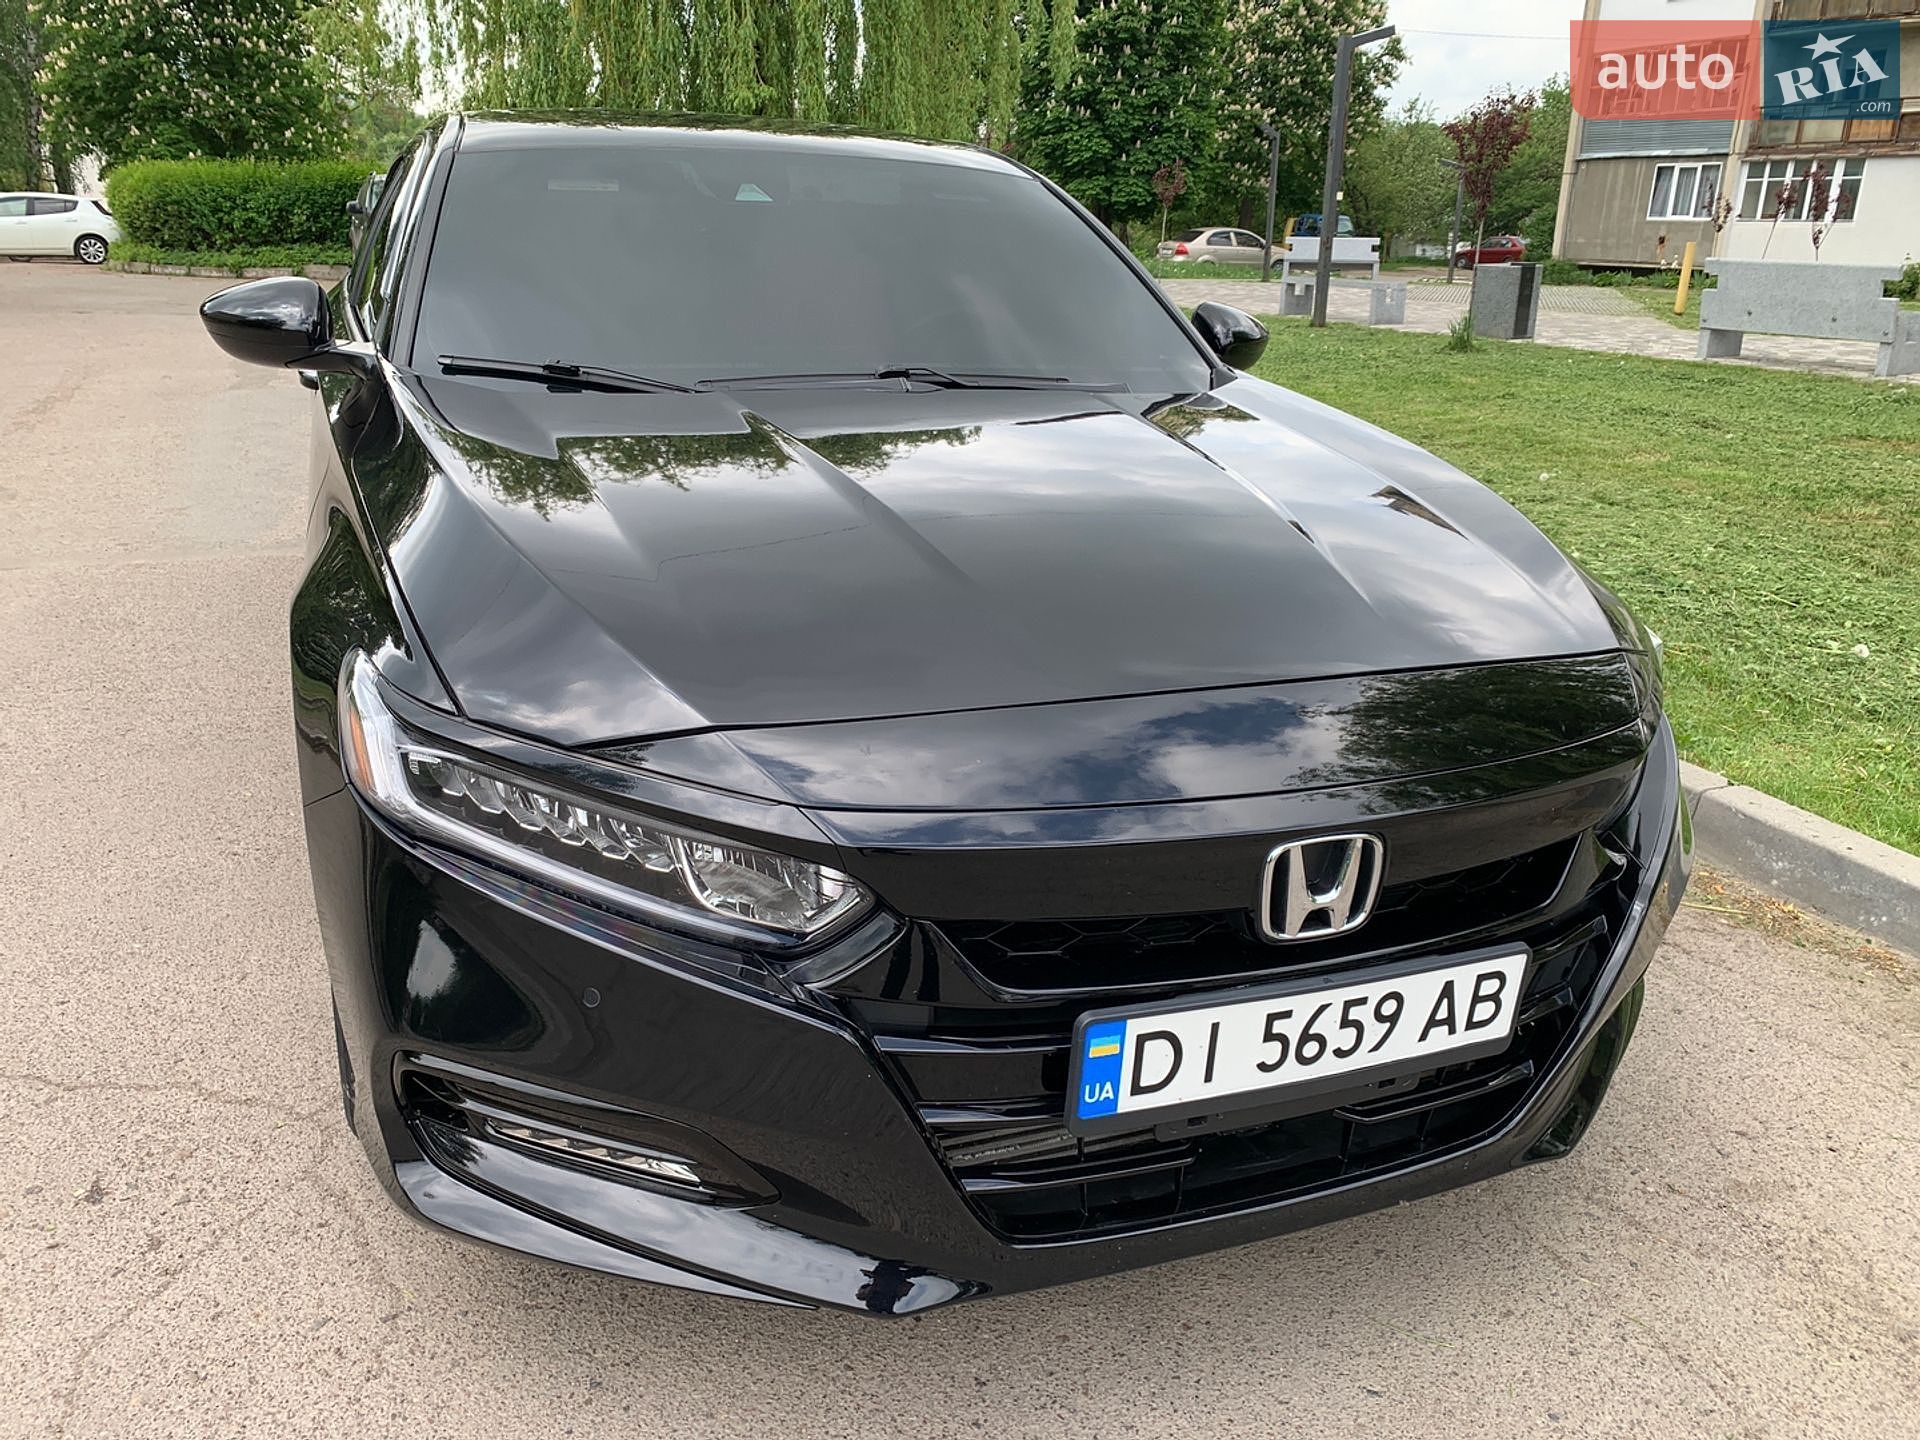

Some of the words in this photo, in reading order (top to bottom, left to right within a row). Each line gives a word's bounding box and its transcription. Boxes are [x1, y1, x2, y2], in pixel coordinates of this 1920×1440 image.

[1130, 1021, 1220, 1096] DI
[1255, 990, 1406, 1073] 5659
[1417, 970, 1507, 1043] AB
[1084, 1081, 1115, 1103] UA
